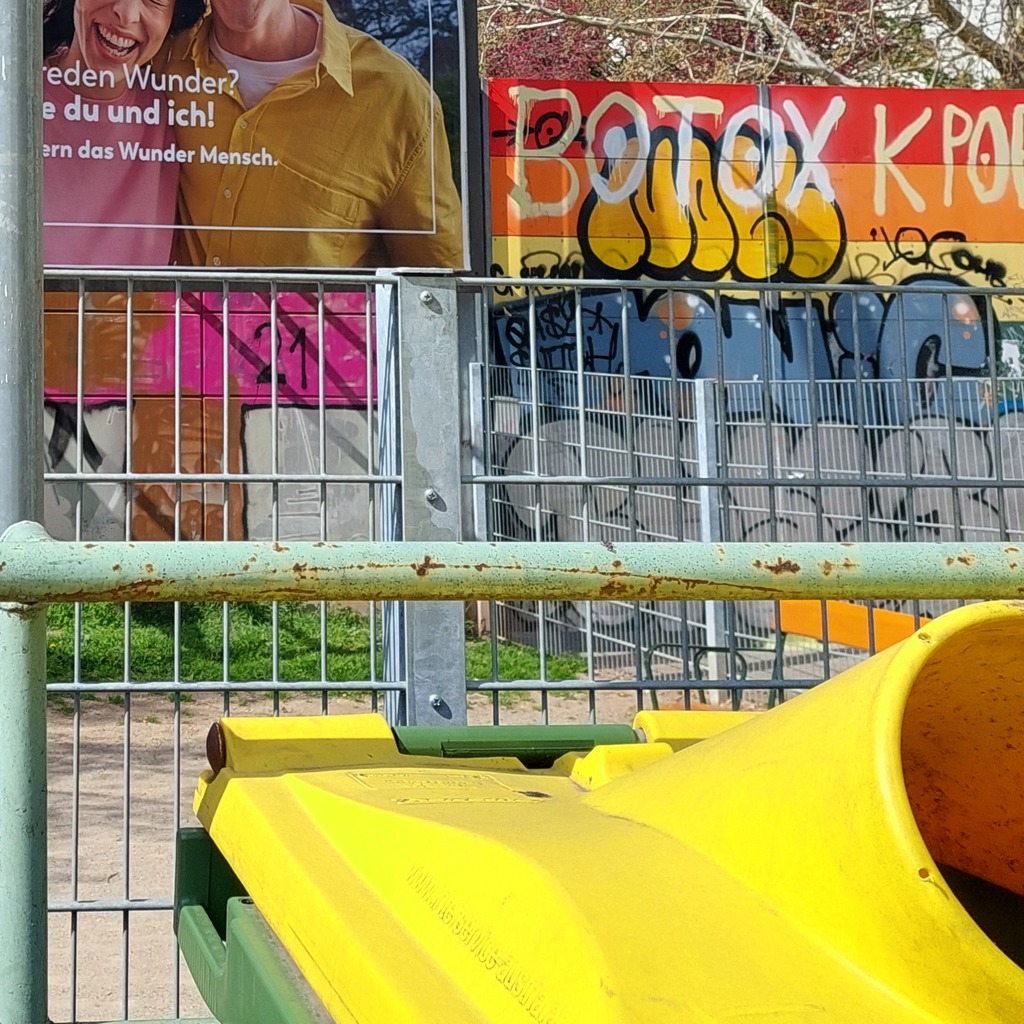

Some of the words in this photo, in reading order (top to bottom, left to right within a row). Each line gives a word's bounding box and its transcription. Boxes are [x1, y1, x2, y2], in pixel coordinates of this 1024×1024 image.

[122, 63, 239, 95] Wunder?
[64, 94, 99, 122] du
[107, 99, 160, 125] und
[167, 99, 215, 128] ich!
[78, 139, 114, 160] das
[118, 141, 196, 164] Wunder
[200, 145, 279, 167] Mensch.
[508, 85, 846, 220] BOTOX
